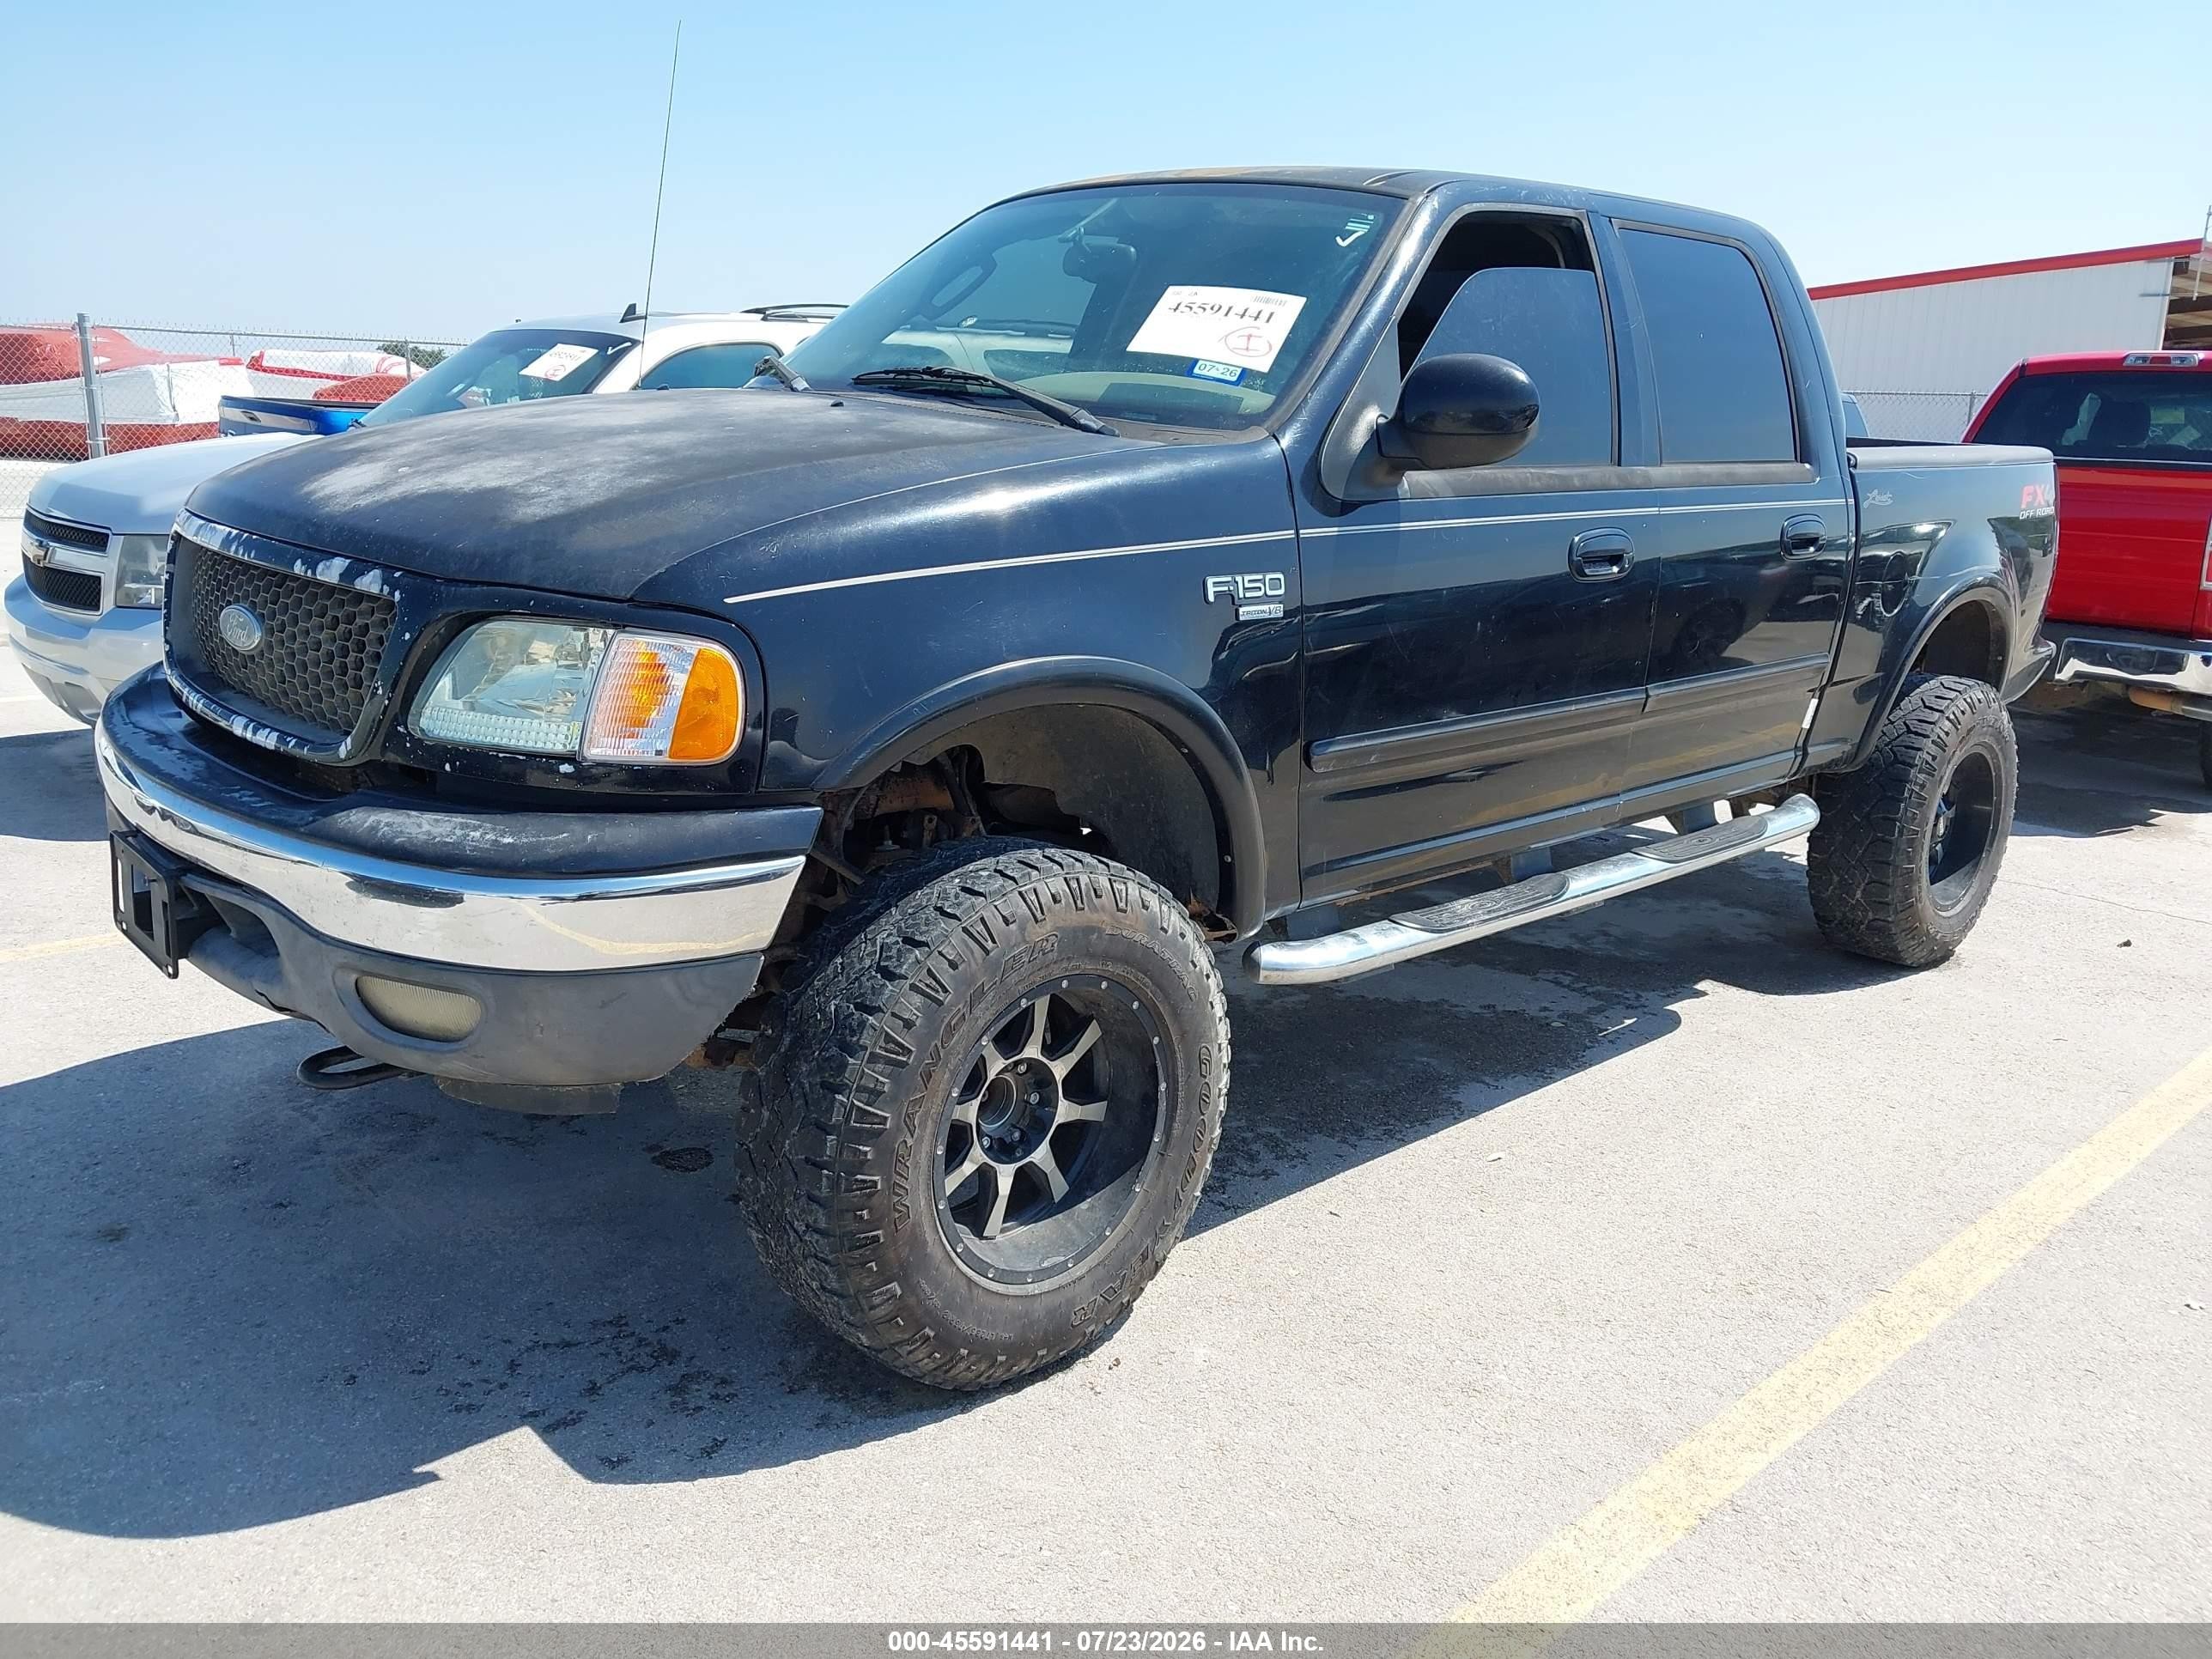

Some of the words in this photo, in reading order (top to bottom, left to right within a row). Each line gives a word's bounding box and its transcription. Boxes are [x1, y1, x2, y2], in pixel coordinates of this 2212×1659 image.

[1169, 301, 1275, 324] 45591441
[2020, 509, 2034, 519] OFF
[2036, 507, 2055, 516] ROAD
[1268, 605, 1281, 616] V8
[228, 613, 249, 642] Ford
[1105, 927, 1198, 1002] DURATRAC
[895, 931, 1060, 1235] WRANGLER
[1071, 1044, 1212, 1322] GOODYEAR
